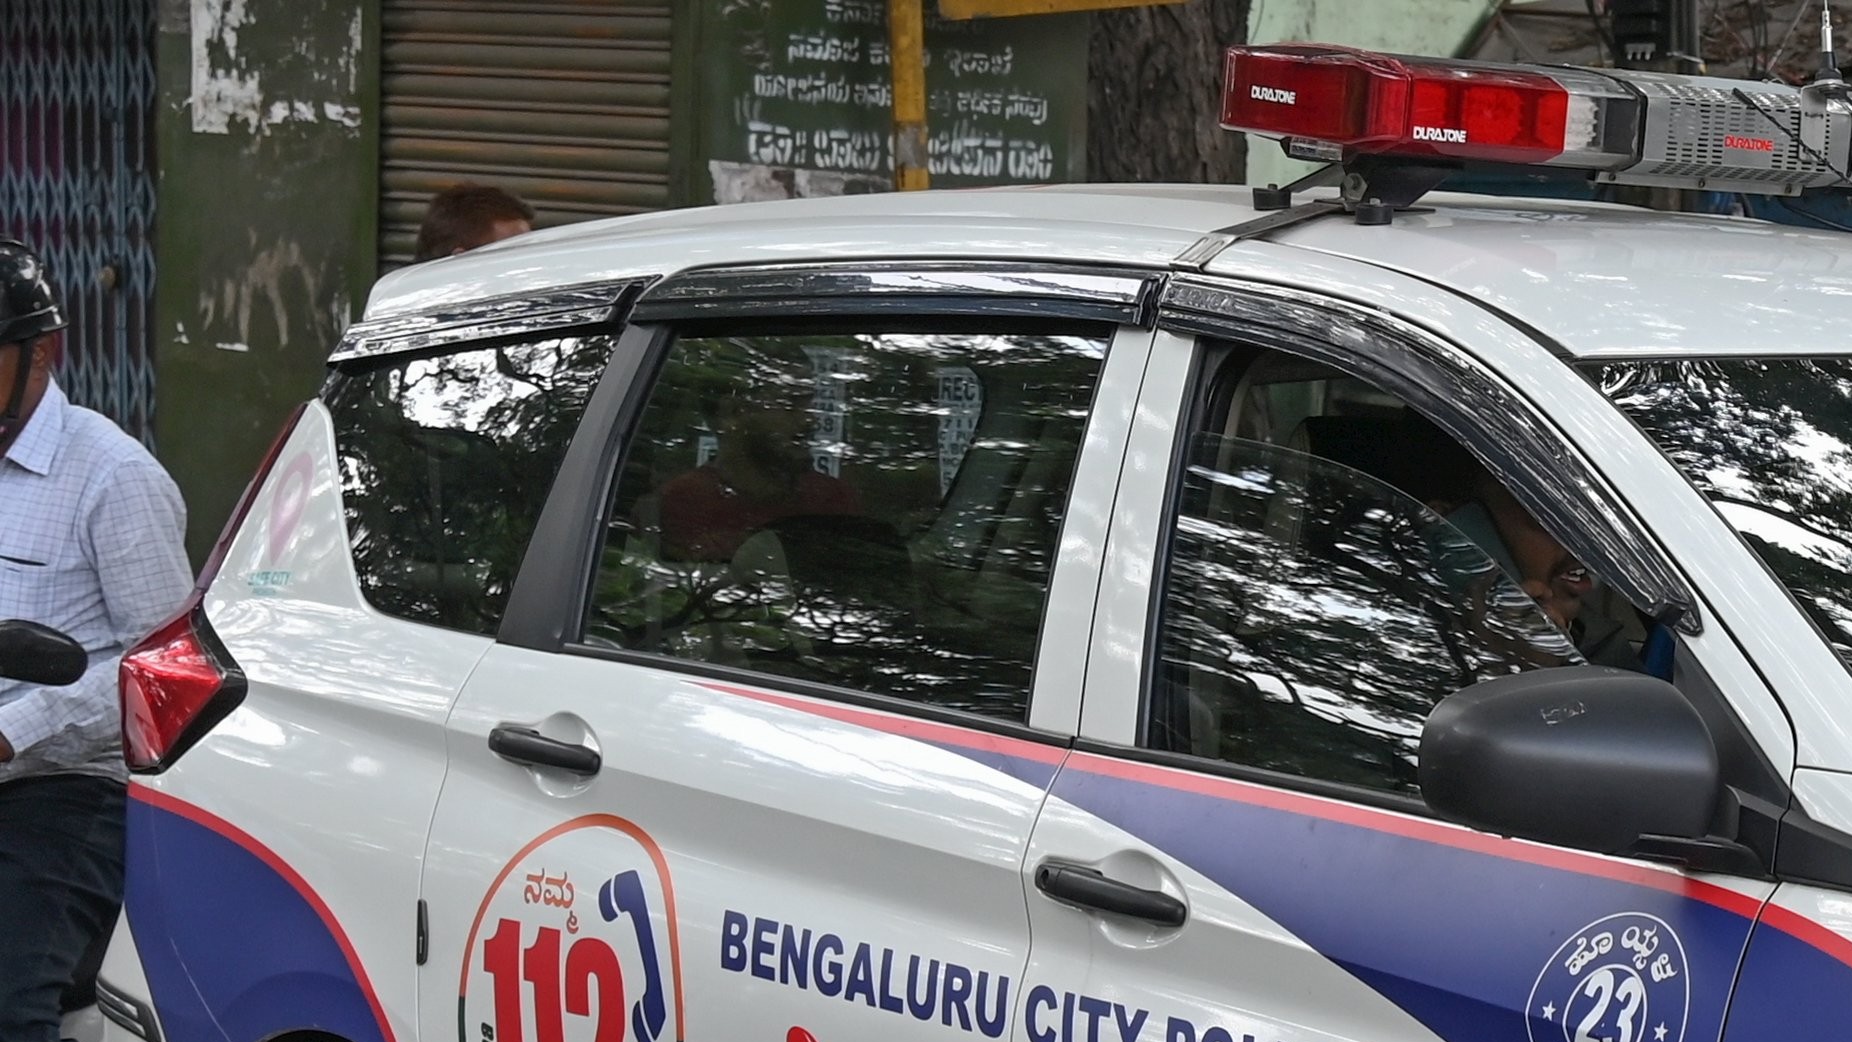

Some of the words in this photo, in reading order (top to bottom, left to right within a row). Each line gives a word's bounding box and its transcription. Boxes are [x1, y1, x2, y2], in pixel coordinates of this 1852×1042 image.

[1251, 85, 1296, 105] DURATONE
[1413, 126, 1467, 143] DURATONE
[1724, 135, 1774, 151] DURATONE
[523, 868, 579, 934] ನಮ್ಮ
[721, 910, 1009, 1039] BENGALURU
